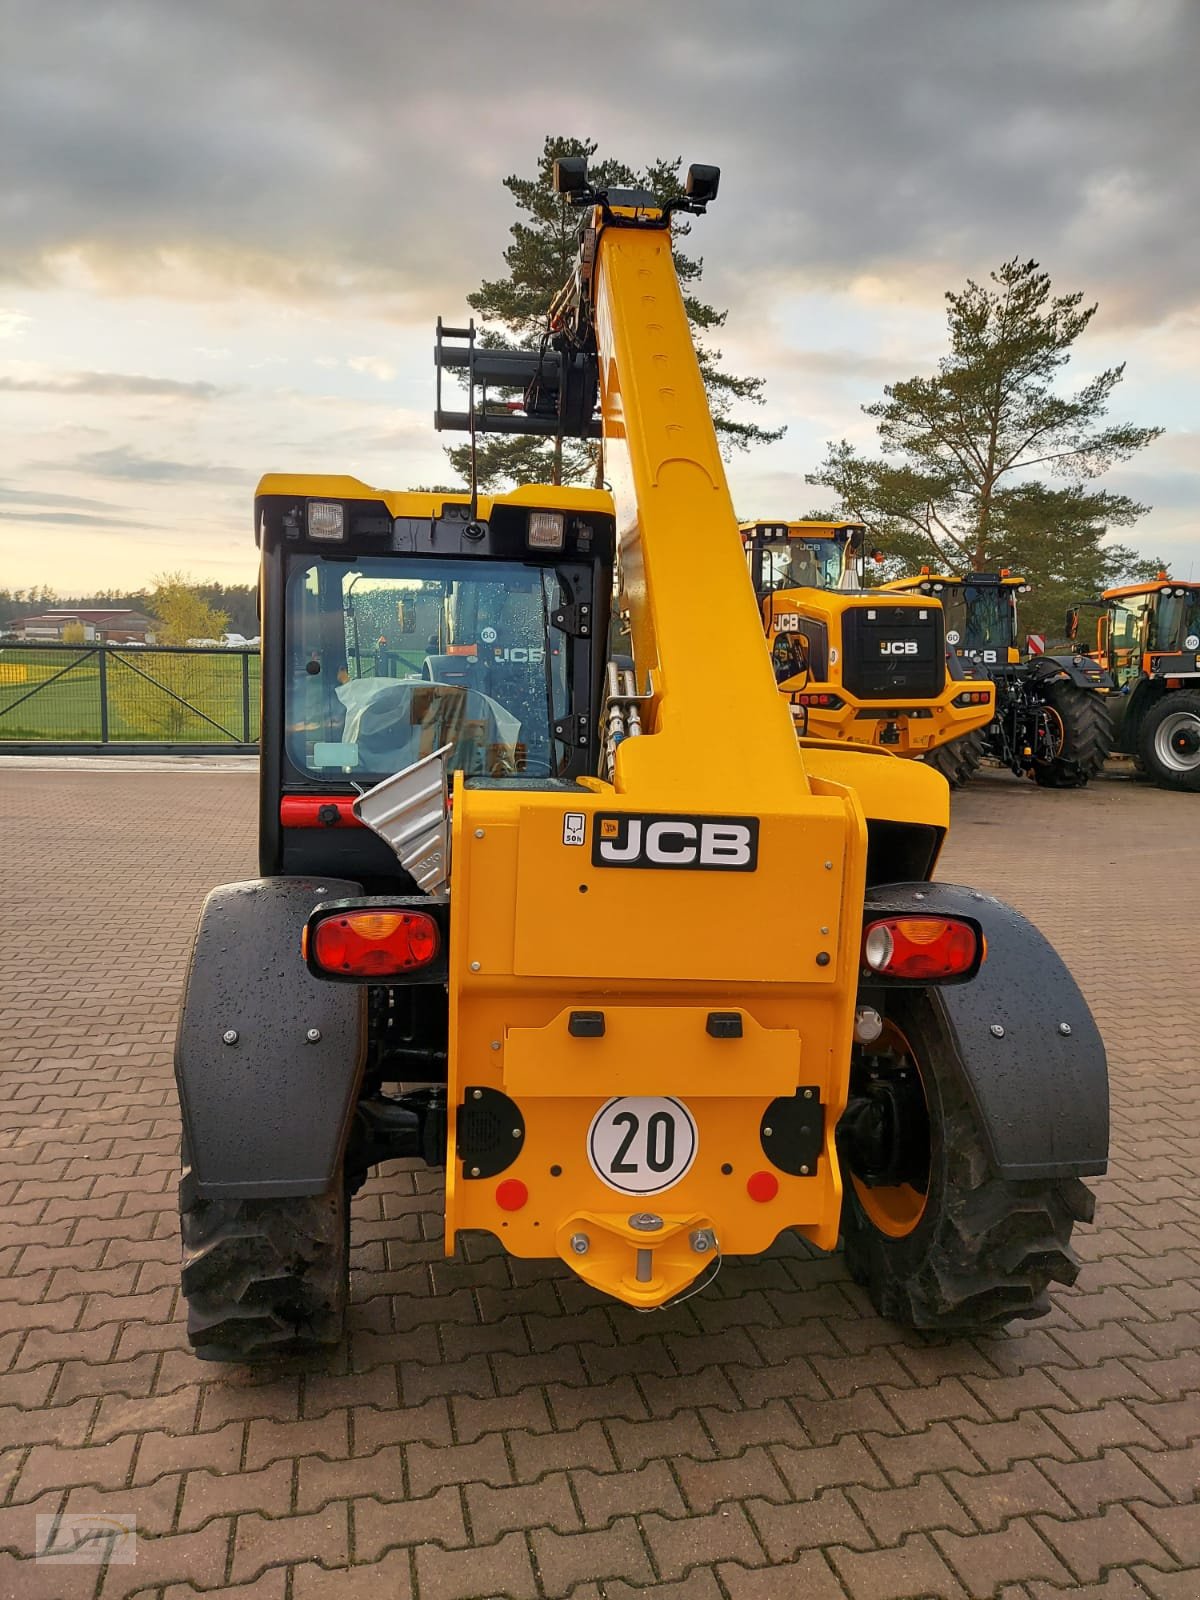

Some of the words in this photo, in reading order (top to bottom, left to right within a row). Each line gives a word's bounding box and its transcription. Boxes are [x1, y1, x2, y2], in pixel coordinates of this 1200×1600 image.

[799, 543, 821, 551] JCB
[774, 614, 799, 631] JCB
[482, 631, 495, 639] 60
[881, 642, 919, 654] JCB
[600, 820, 751, 865] JCB
[610, 1111, 675, 1173] 20
